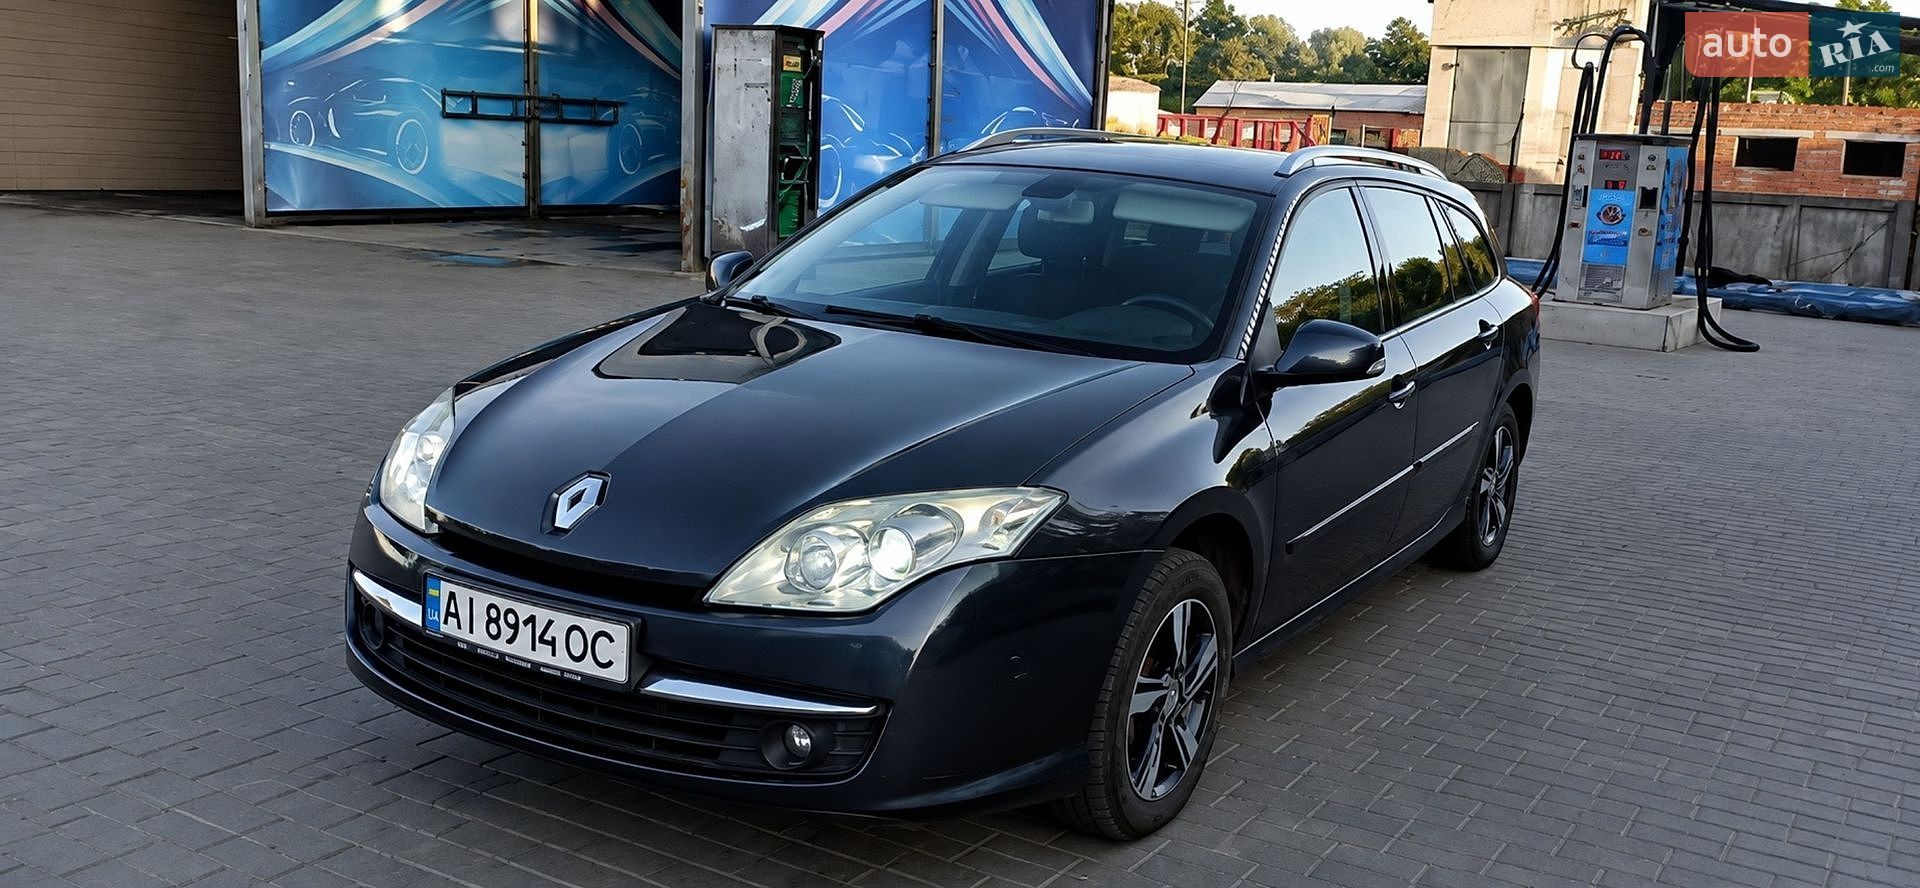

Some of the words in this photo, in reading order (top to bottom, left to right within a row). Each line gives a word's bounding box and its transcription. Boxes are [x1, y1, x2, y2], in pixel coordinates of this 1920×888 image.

[442, 590, 474, 635] AI
[485, 602, 557, 658] 8914
[564, 624, 615, 669] OC
